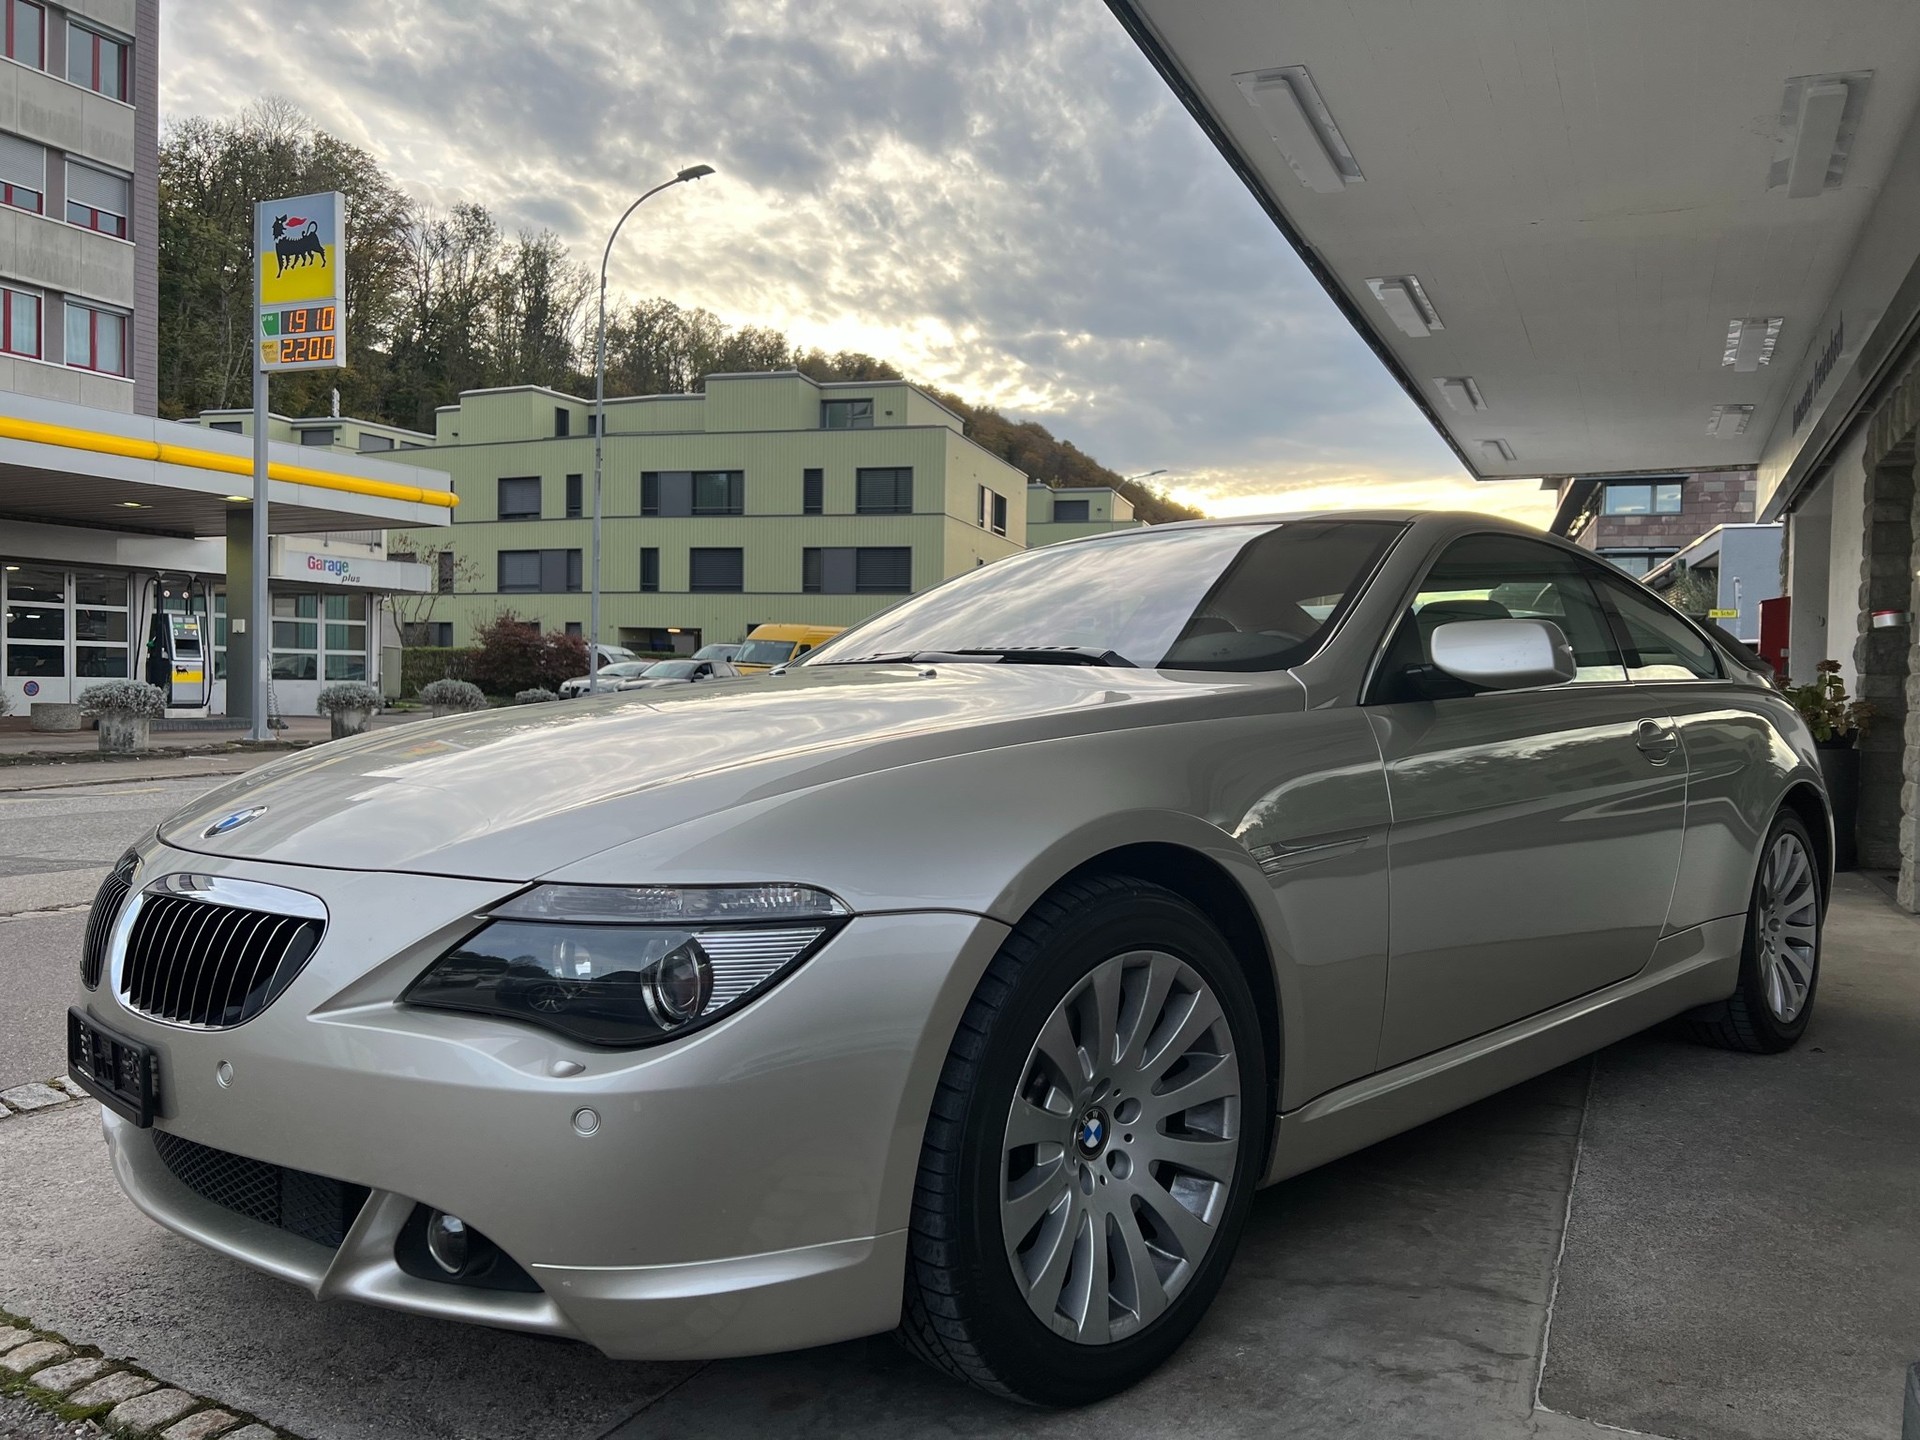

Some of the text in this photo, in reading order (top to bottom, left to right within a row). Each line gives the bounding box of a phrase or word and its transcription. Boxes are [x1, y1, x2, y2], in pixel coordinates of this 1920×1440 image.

[281, 336, 335, 362] 2.200
[307, 555, 349, 576] Garage
[341, 575, 361, 583] plus
